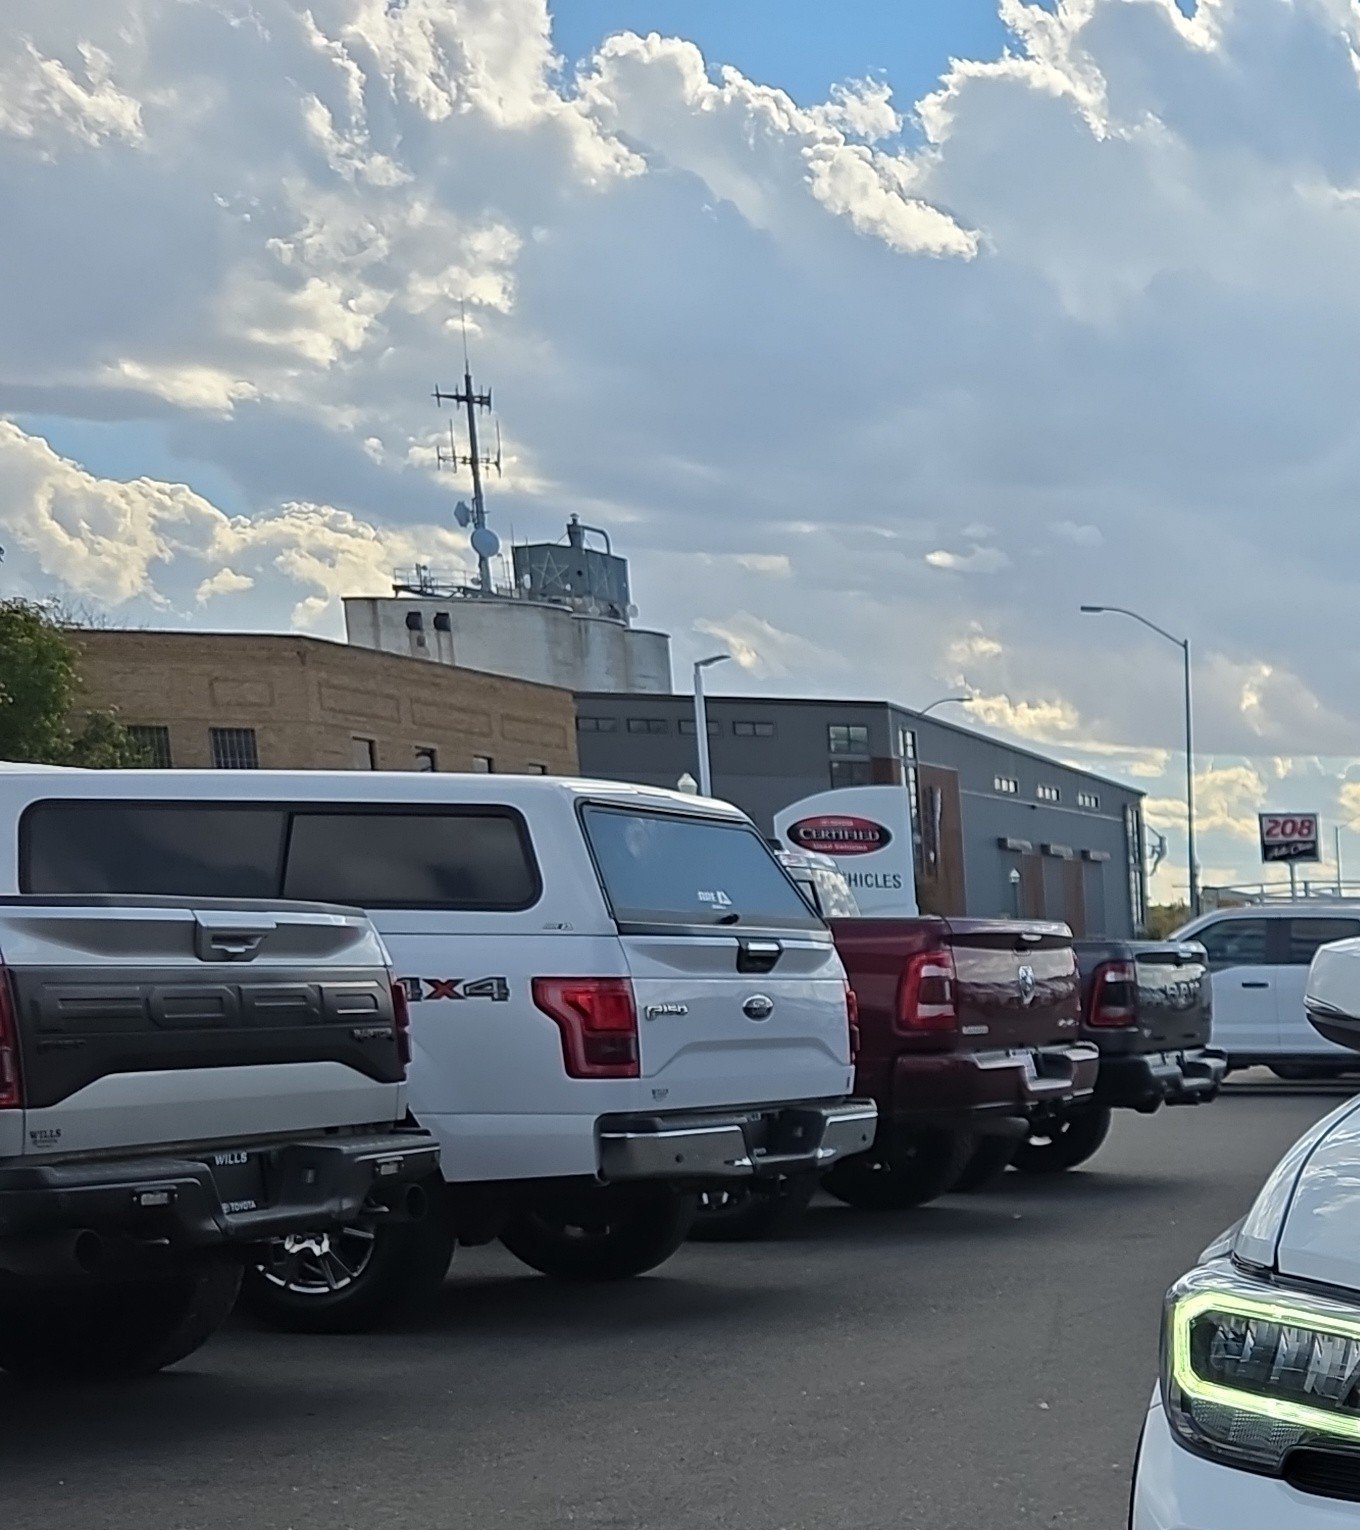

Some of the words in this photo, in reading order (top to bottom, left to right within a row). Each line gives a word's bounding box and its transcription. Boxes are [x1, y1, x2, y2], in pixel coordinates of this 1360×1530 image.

[799, 828, 880, 841] CERTIFIED
[1266, 819, 1313, 838] 208
[845, 873, 902, 889] HICLES
[215, 1152, 248, 1165] WILLS
[230, 1200, 257, 1211] TOYOTA
